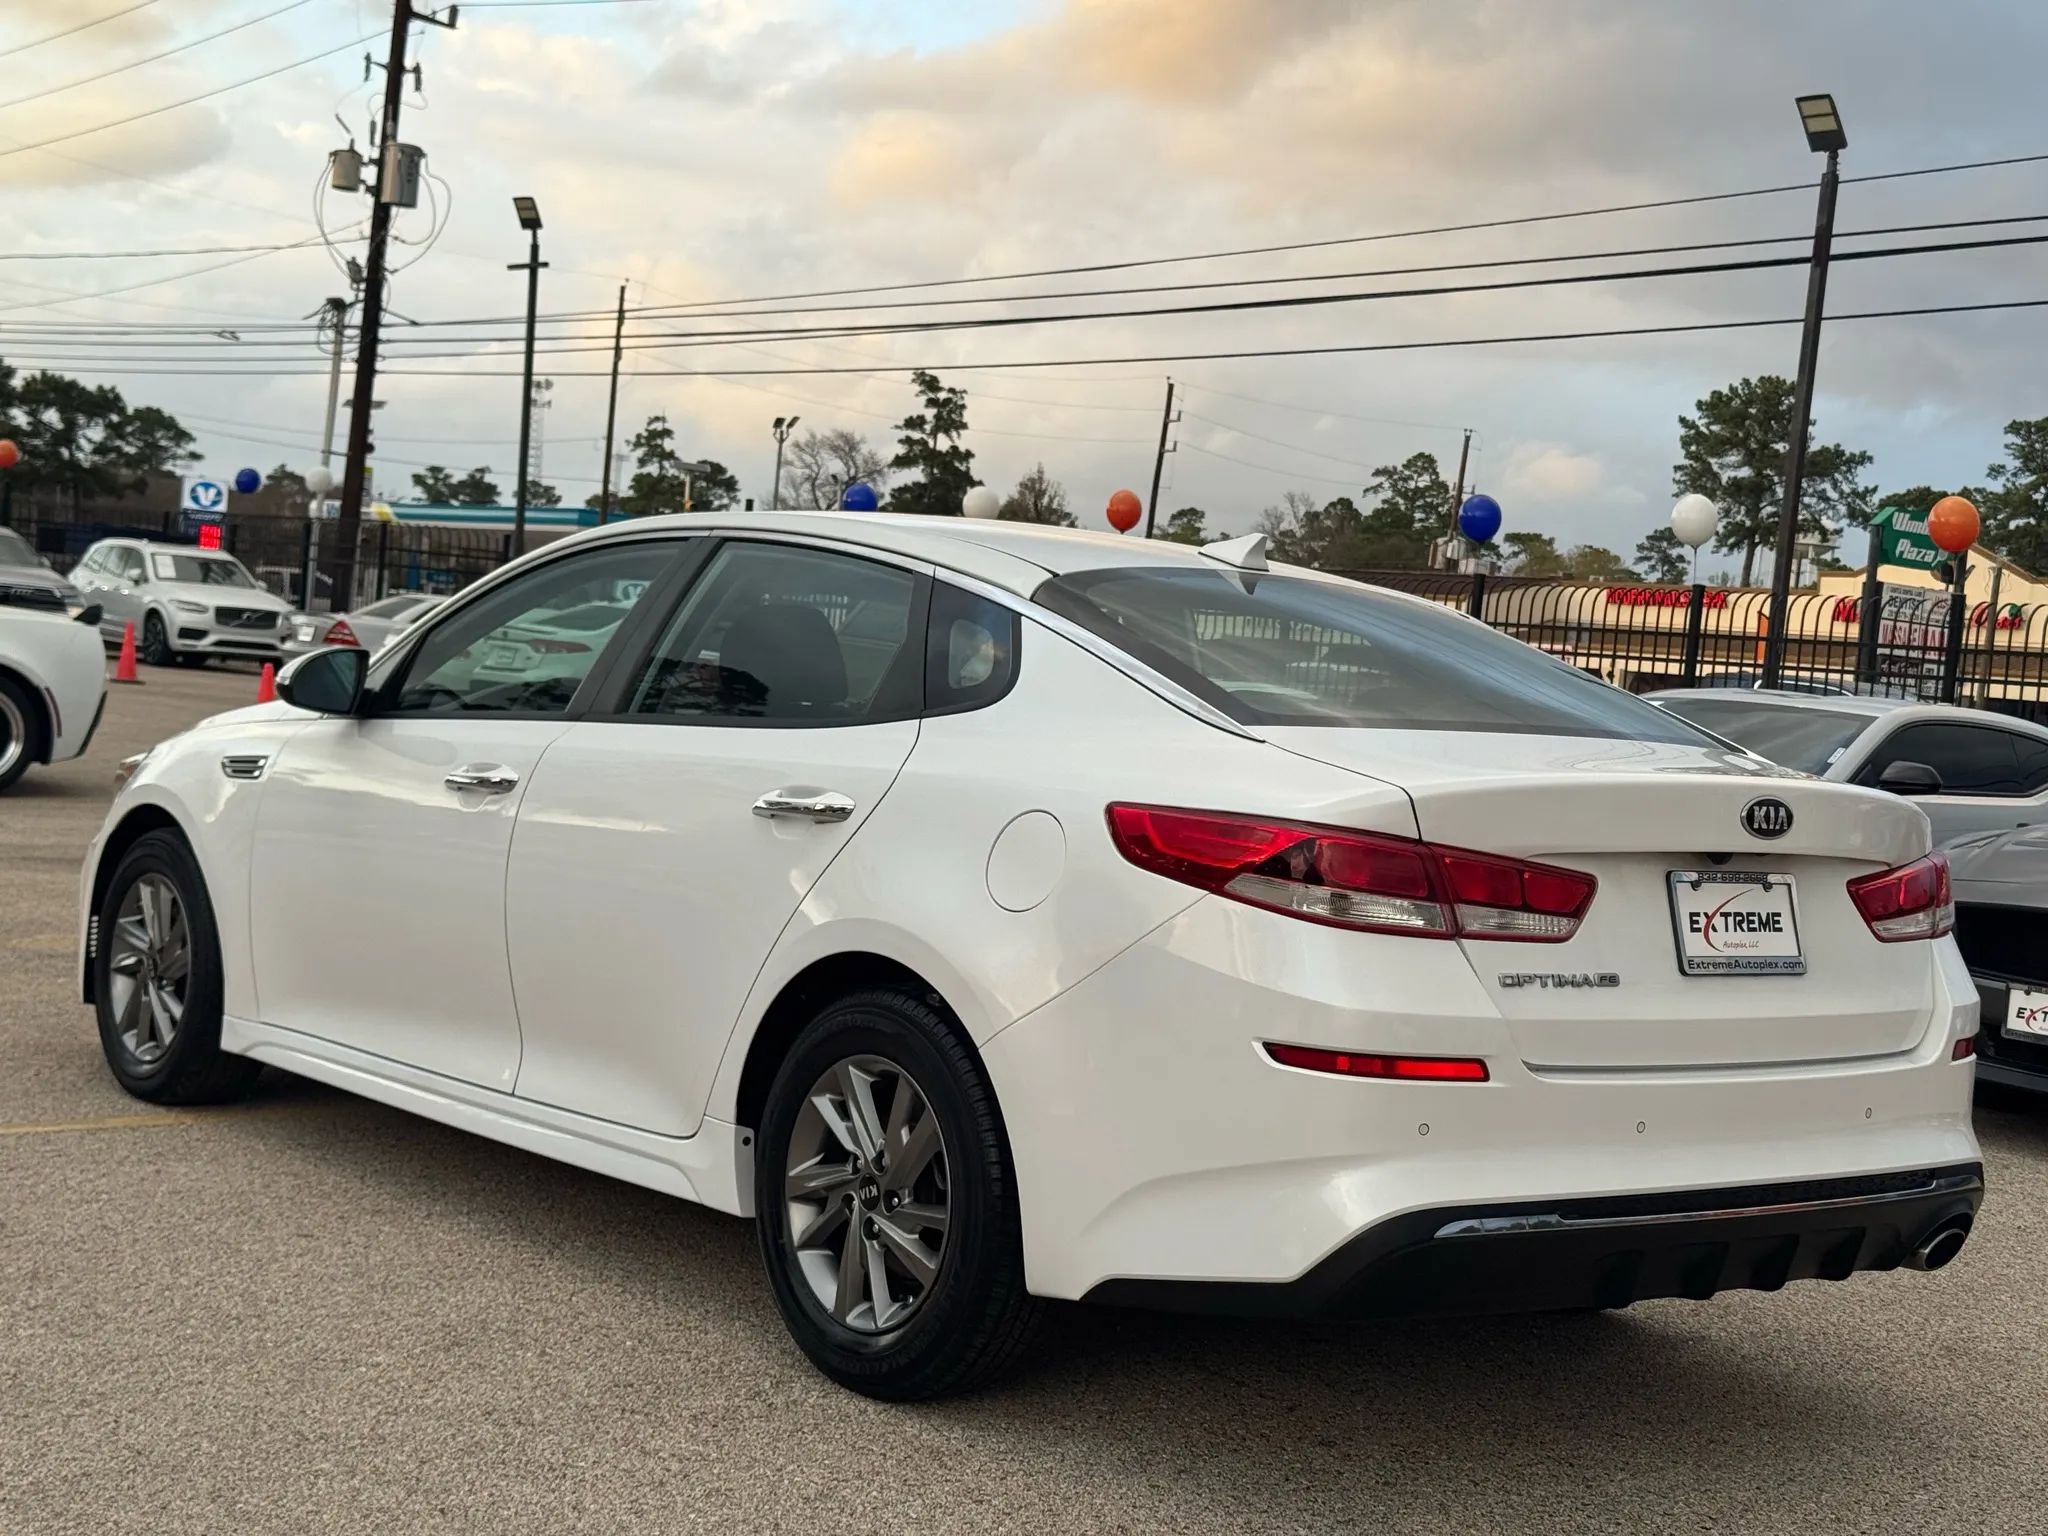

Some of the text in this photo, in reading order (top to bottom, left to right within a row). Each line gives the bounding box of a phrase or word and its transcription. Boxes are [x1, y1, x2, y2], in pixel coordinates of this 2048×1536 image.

[1895, 538, 1936, 563] Plaza
[1753, 806, 1788, 829] KIA
[1689, 912, 1783, 932] EXTREME
[1688, 959, 1804, 971] ExtremeAutoplex.com
[1498, 973, 1594, 988] OPTIMA
[860, 1184, 878, 1200] KIA
